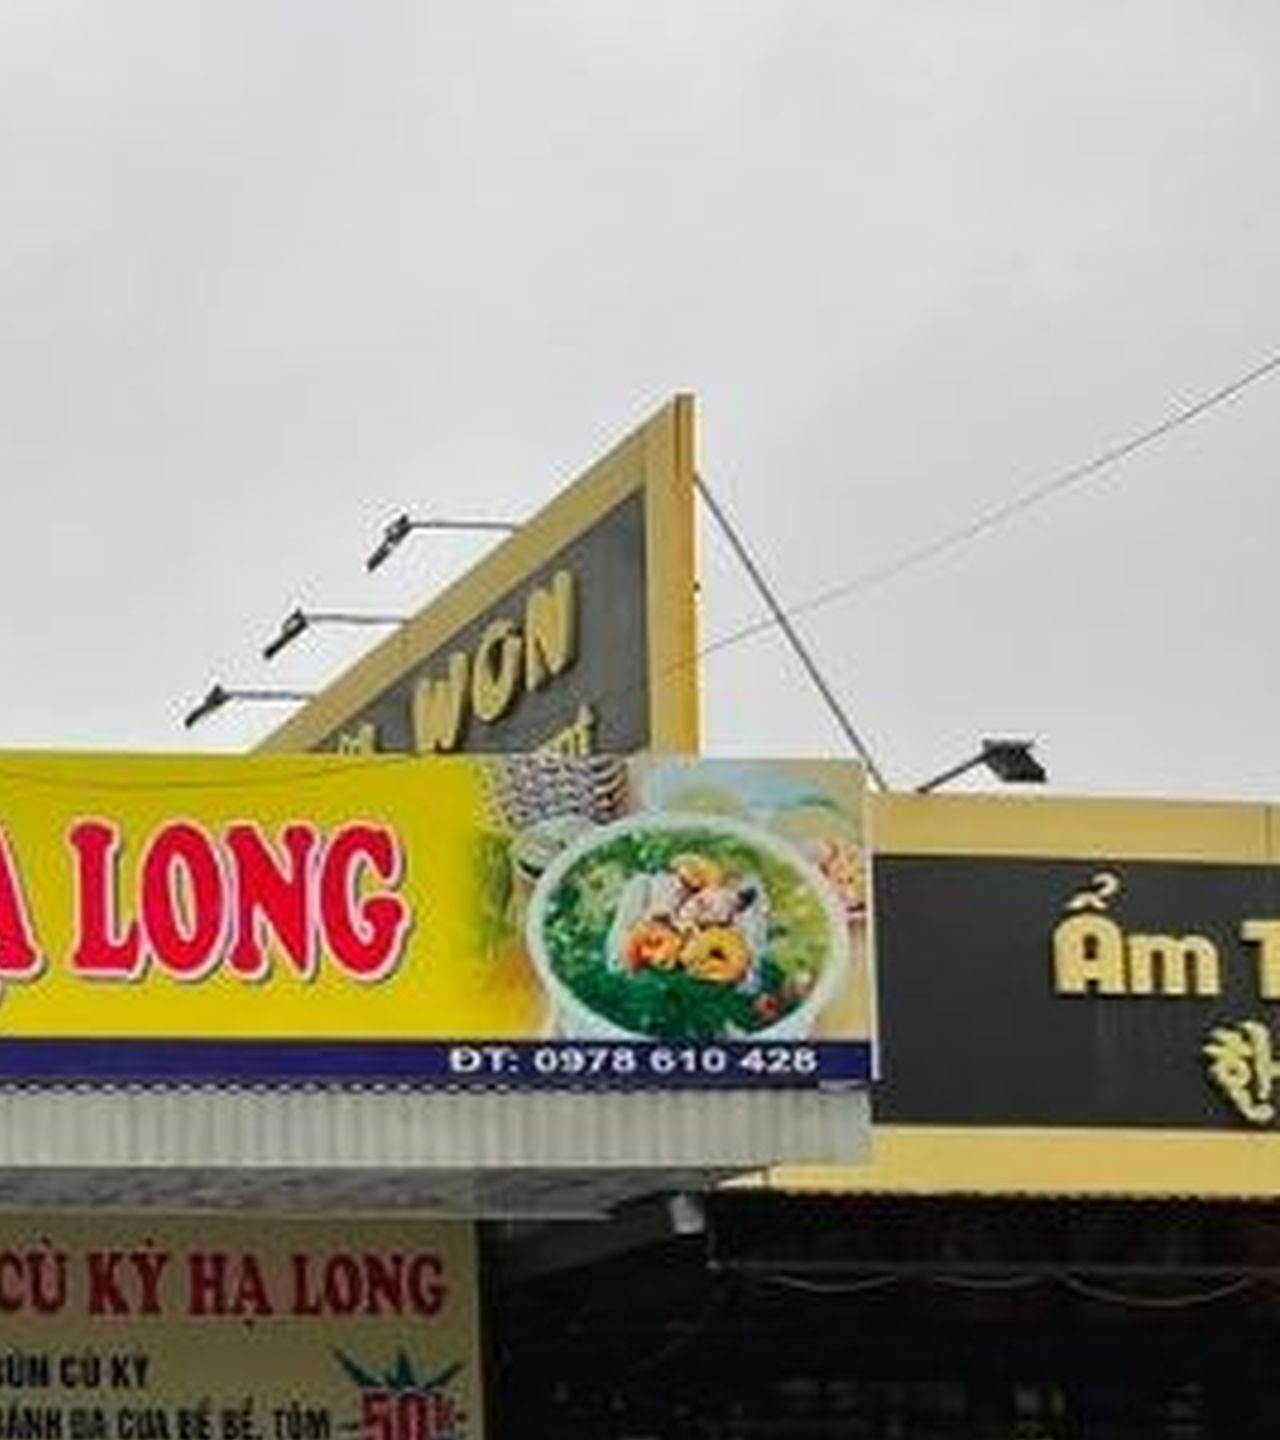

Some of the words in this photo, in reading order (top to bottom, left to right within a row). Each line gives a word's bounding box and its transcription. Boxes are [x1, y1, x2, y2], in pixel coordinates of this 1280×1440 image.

[67, 818, 409, 982] LONG
[1051, 871, 1223, 997] Ẩm
[534, 1047, 637, 1074] 0978
[649, 1047, 727, 1074] 610
[86, 1236, 172, 1316] KỲ
[187, 1252, 274, 1330] HẠ
[291, 1252, 449, 1317] LONG
